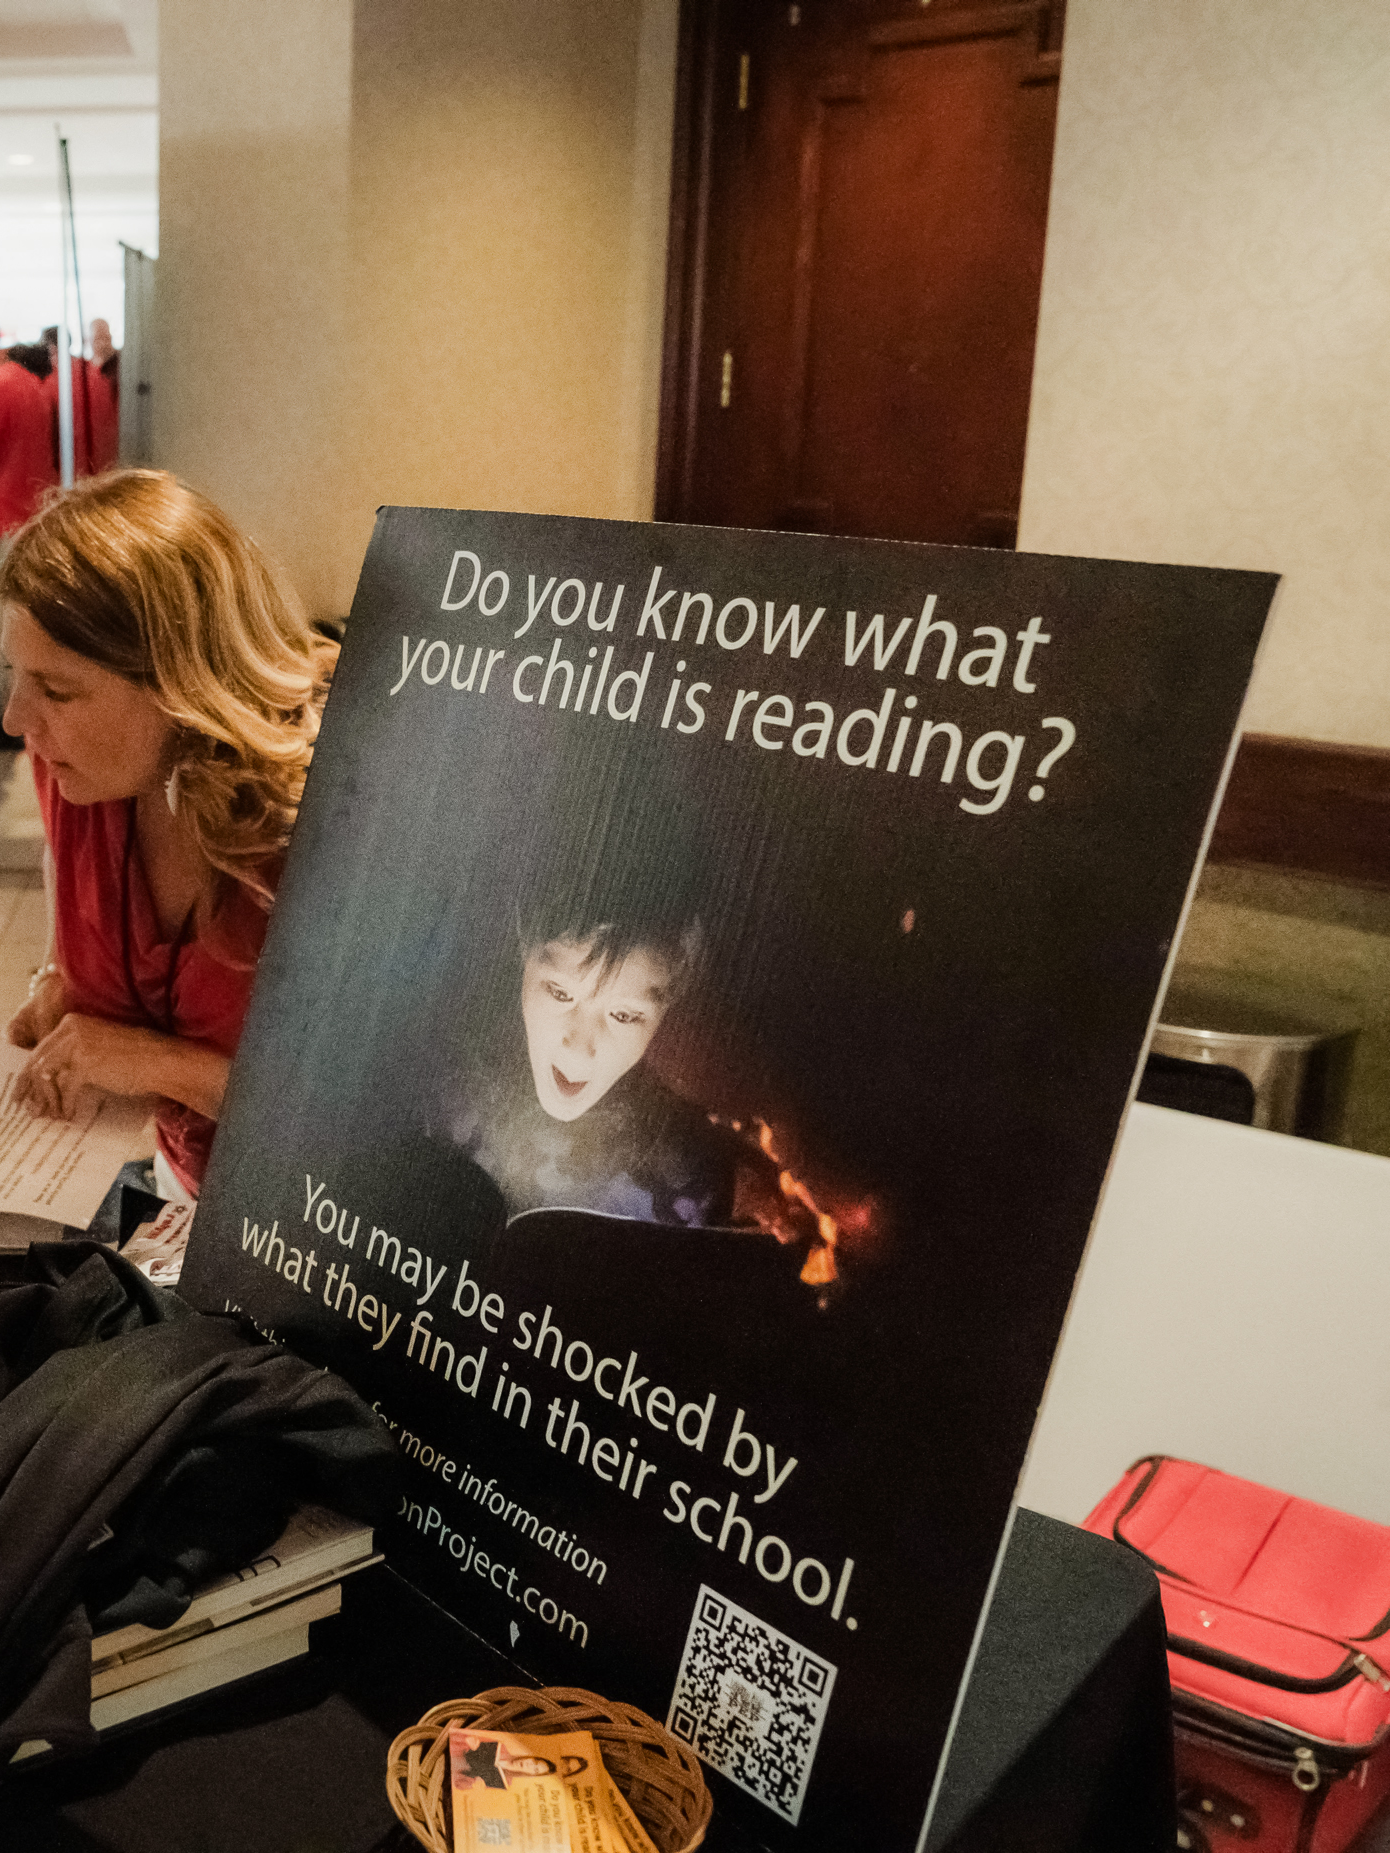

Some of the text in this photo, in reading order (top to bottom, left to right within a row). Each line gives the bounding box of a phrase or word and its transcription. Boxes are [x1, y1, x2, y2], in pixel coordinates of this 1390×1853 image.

[440, 550, 1050, 693] Do you know what
[390, 634, 1076, 815] your child is reading?
[242, 1217, 317, 1293] what
[324, 1263, 401, 1350] they
[407, 1311, 487, 1397] find
[492, 1362, 531, 1428] in
[546, 1398, 657, 1499] their
[663, 1481, 858, 1631] school.
[303, 1174, 798, 1503] You may be shocked by
[400, 1430, 456, 1482] more
[458, 1463, 608, 1585] information
